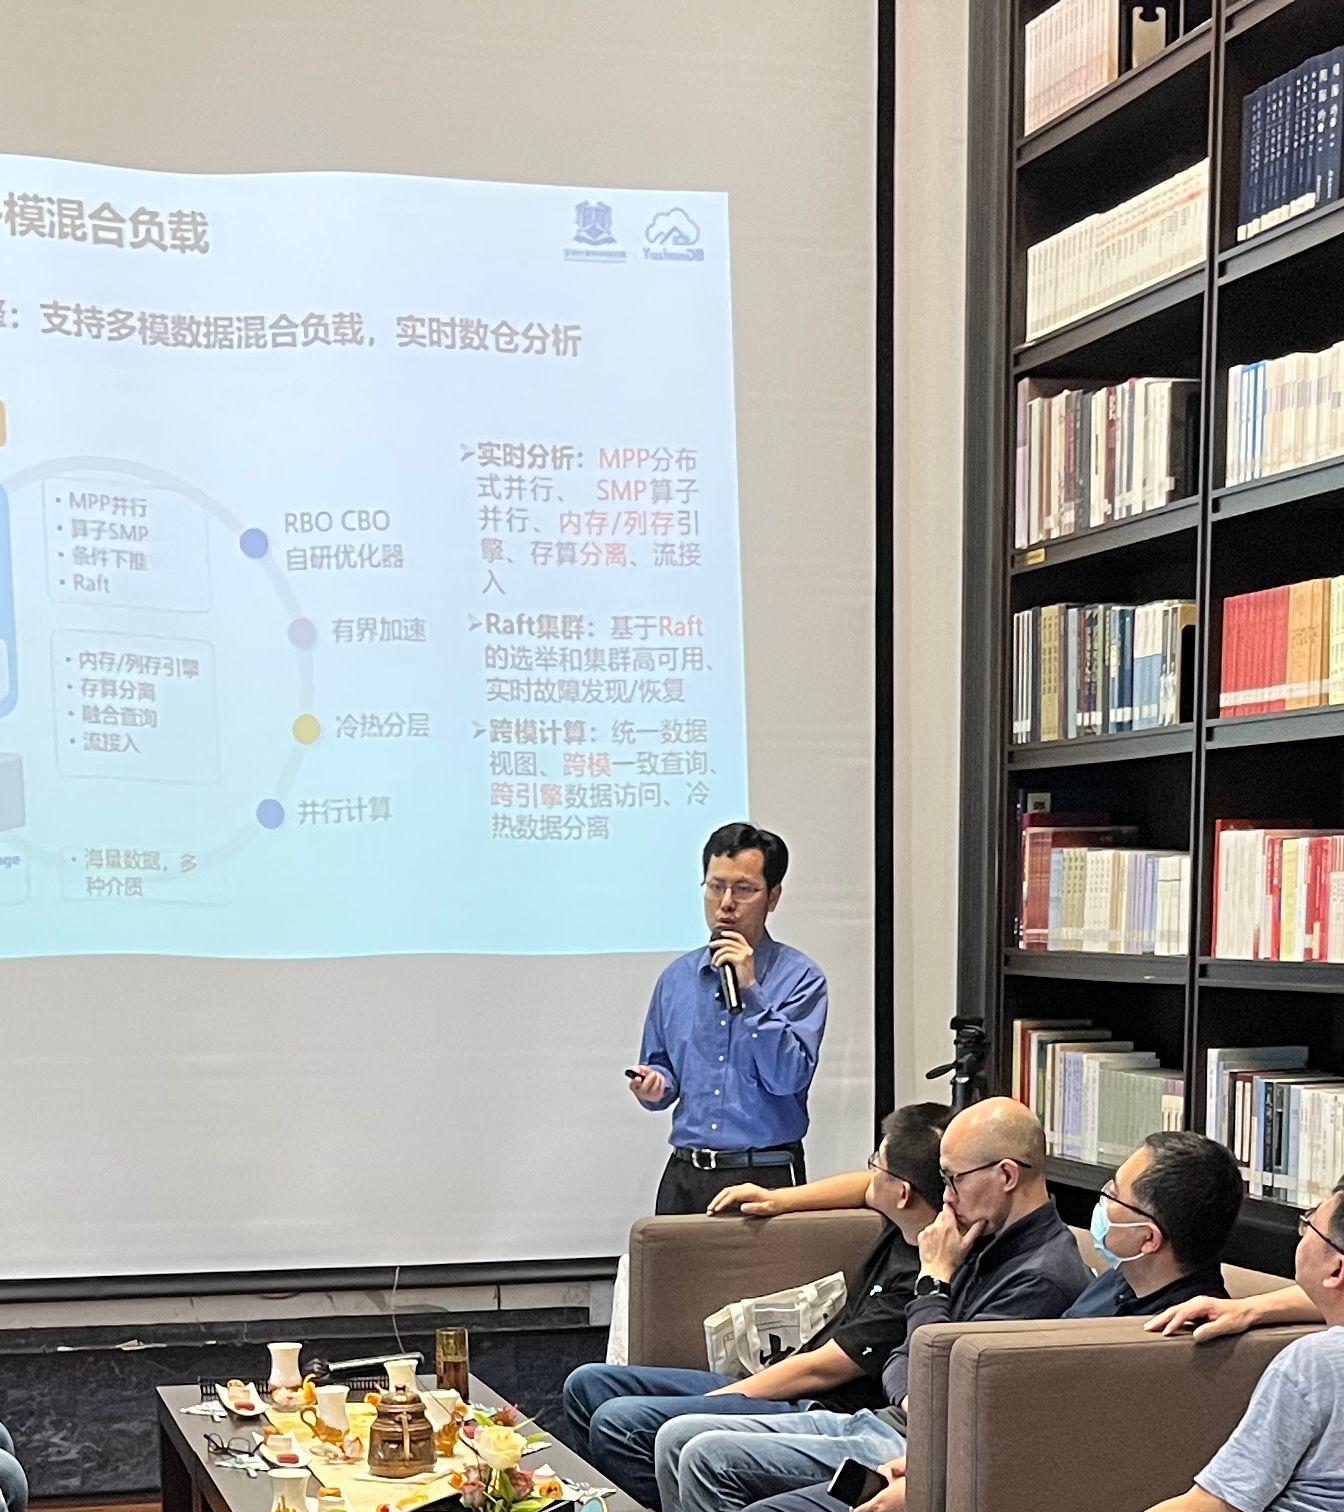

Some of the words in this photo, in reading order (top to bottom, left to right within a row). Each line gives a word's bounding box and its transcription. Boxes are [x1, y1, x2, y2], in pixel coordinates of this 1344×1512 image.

[68, 491, 148, 518] MPP并行
[284, 510, 334, 533] RBO
[340, 508, 391, 532] CBO
[286, 543, 405, 571] 自研优化器
[72, 573, 111, 594] Raft
[481, 569, 506, 595] 入
[331, 616, 427, 643] 有界加速
[335, 712, 431, 739] 冷热分层
[297, 795, 393, 826] 并行计算
[490, 813, 610, 842] 热数据分离
